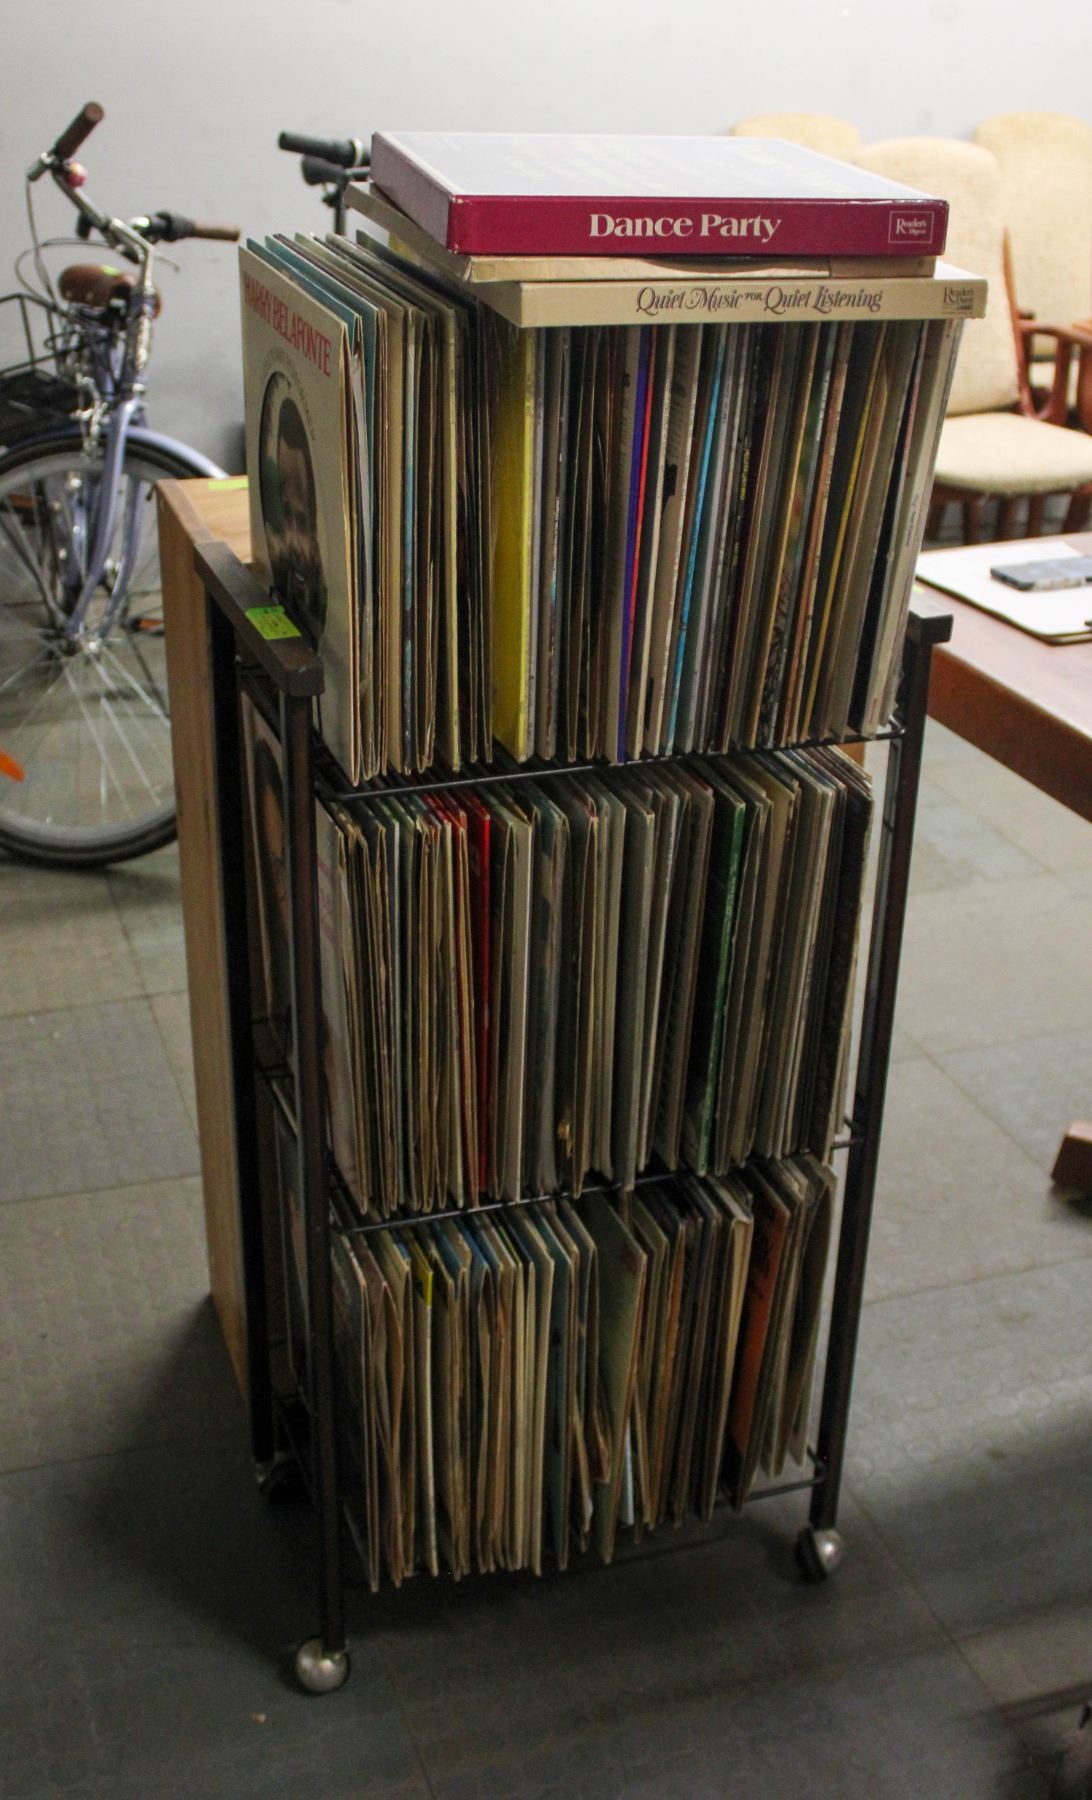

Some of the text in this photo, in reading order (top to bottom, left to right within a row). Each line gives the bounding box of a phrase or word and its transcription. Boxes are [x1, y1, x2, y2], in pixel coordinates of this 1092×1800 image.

[589, 213, 782, 243] Dance Party
[636, 287, 685, 316] Quiet
[685, 287, 743, 313] Music
[764, 286, 811, 315] Quiet
[812, 285, 883, 314] Listening
[244, 273, 331, 377] HARRY BELAFONTE
